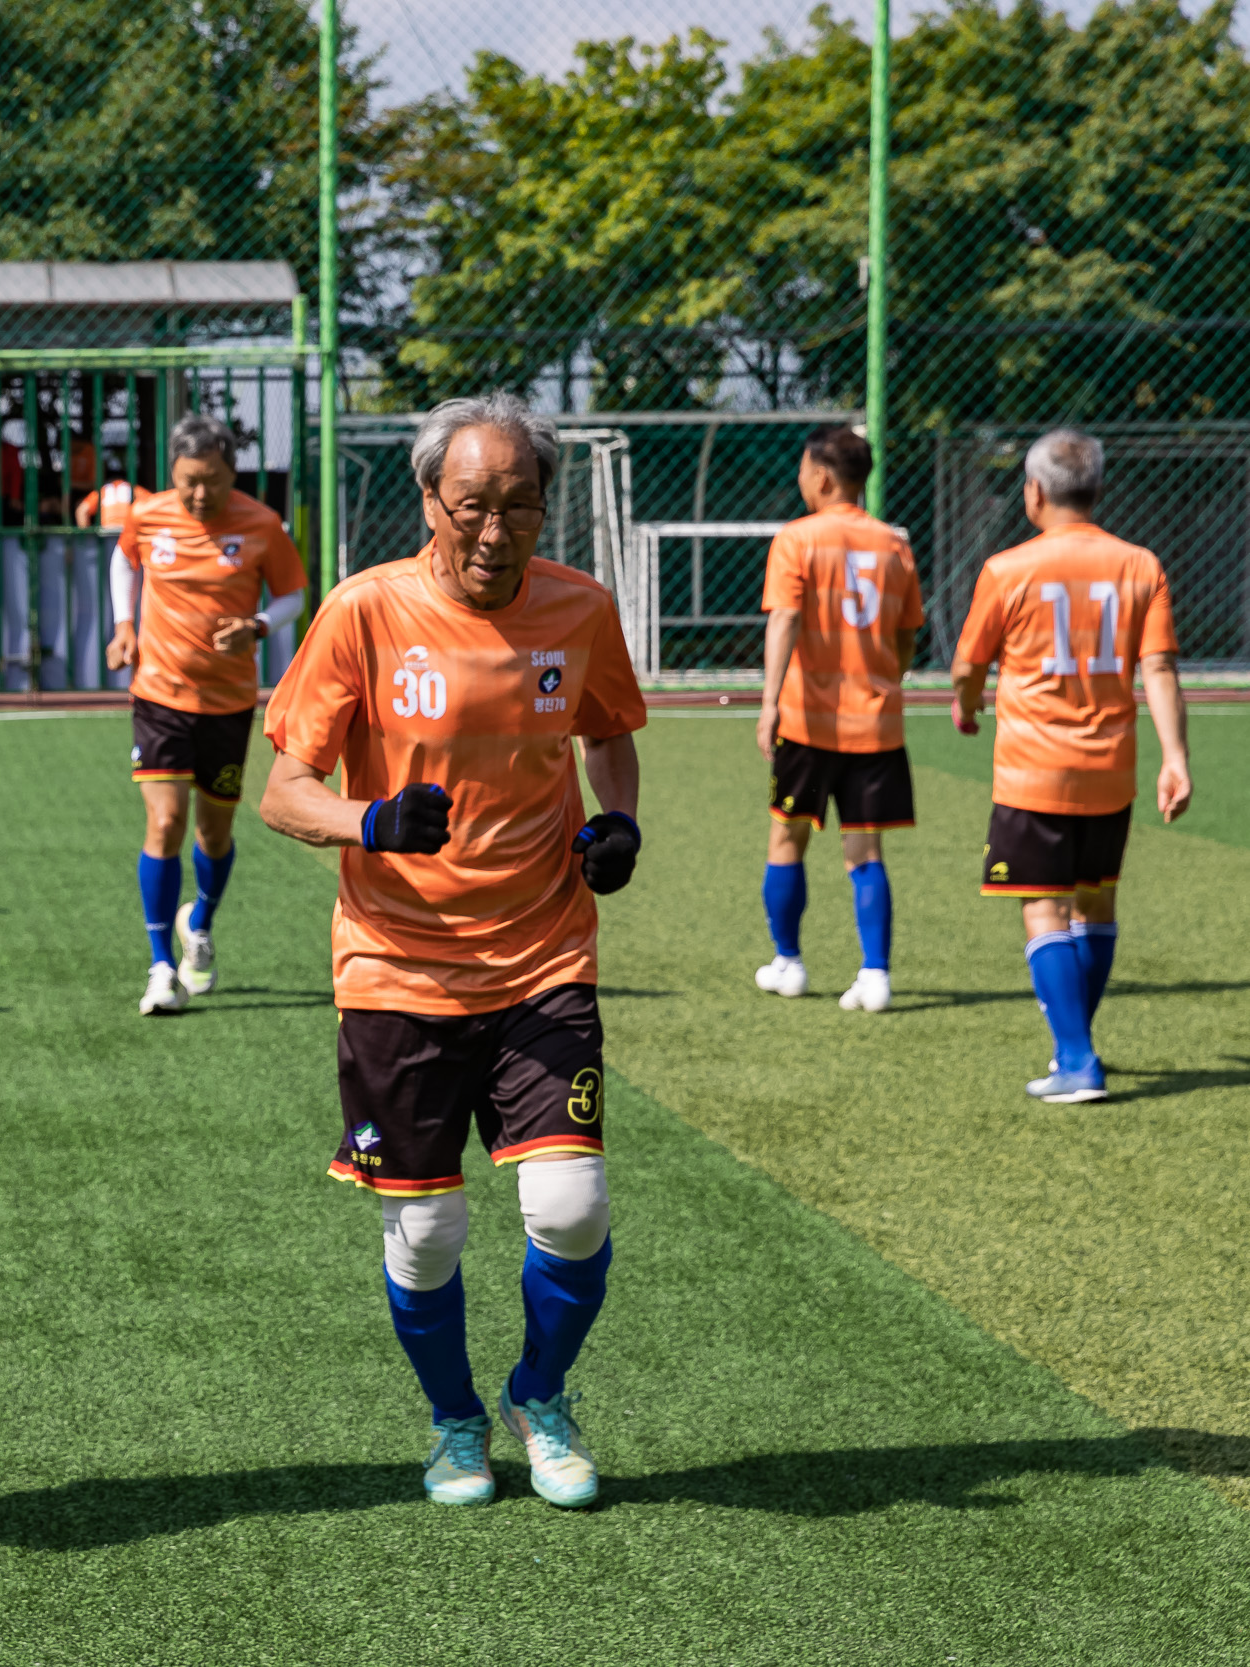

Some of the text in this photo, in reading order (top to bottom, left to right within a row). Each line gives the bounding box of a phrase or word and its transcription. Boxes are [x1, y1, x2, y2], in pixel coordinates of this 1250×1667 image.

[841, 549, 880, 630] 5
[530, 650, 567, 667] SEOUL
[1040, 581, 1125, 676] 11
[392, 667, 447, 720] 30
